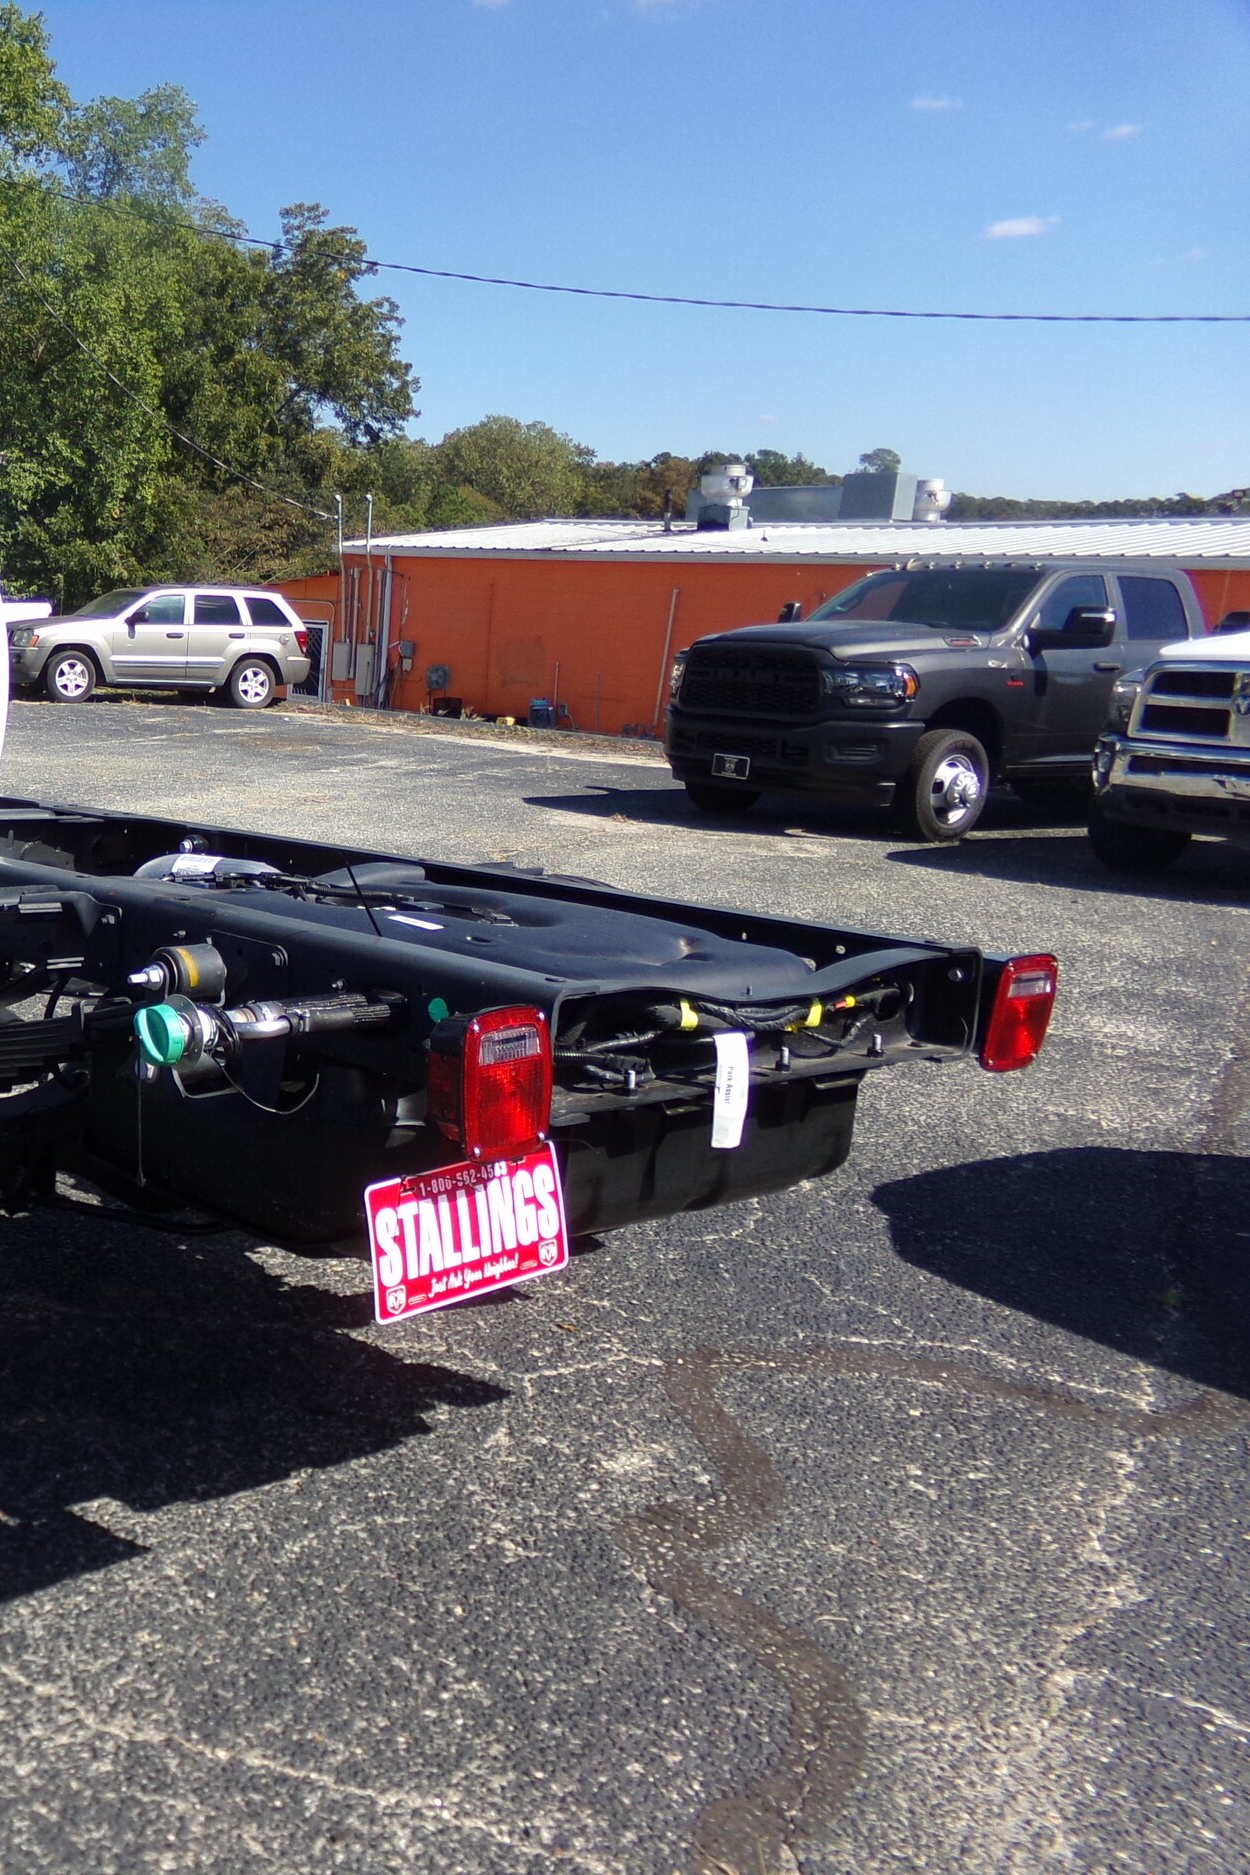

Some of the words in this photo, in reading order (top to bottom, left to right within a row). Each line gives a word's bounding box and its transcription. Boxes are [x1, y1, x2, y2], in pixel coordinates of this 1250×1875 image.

[375, 1163, 560, 1288] STALLINGS
[427, 1276, 448, 1298] Just
[448, 1269, 463, 1289] Ask
[463, 1267, 483, 1290] Your
